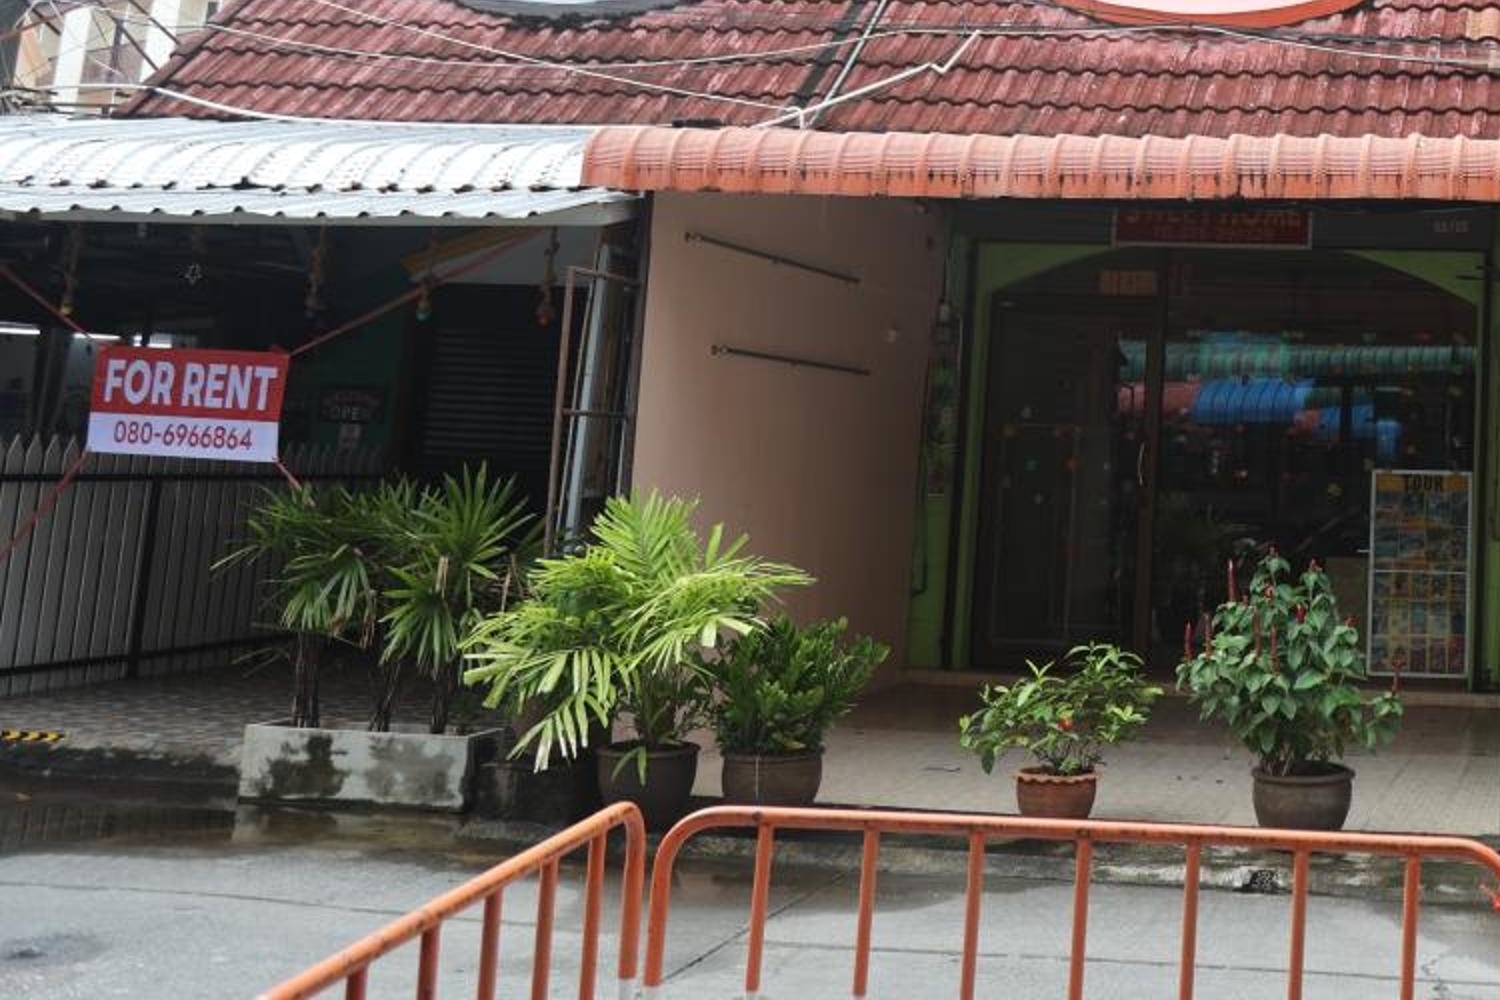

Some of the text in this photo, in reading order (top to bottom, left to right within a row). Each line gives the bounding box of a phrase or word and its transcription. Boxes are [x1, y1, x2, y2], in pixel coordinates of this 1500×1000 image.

[102, 358, 279, 411] FOR RENT
[113, 420, 253, 451] 080-6966864
